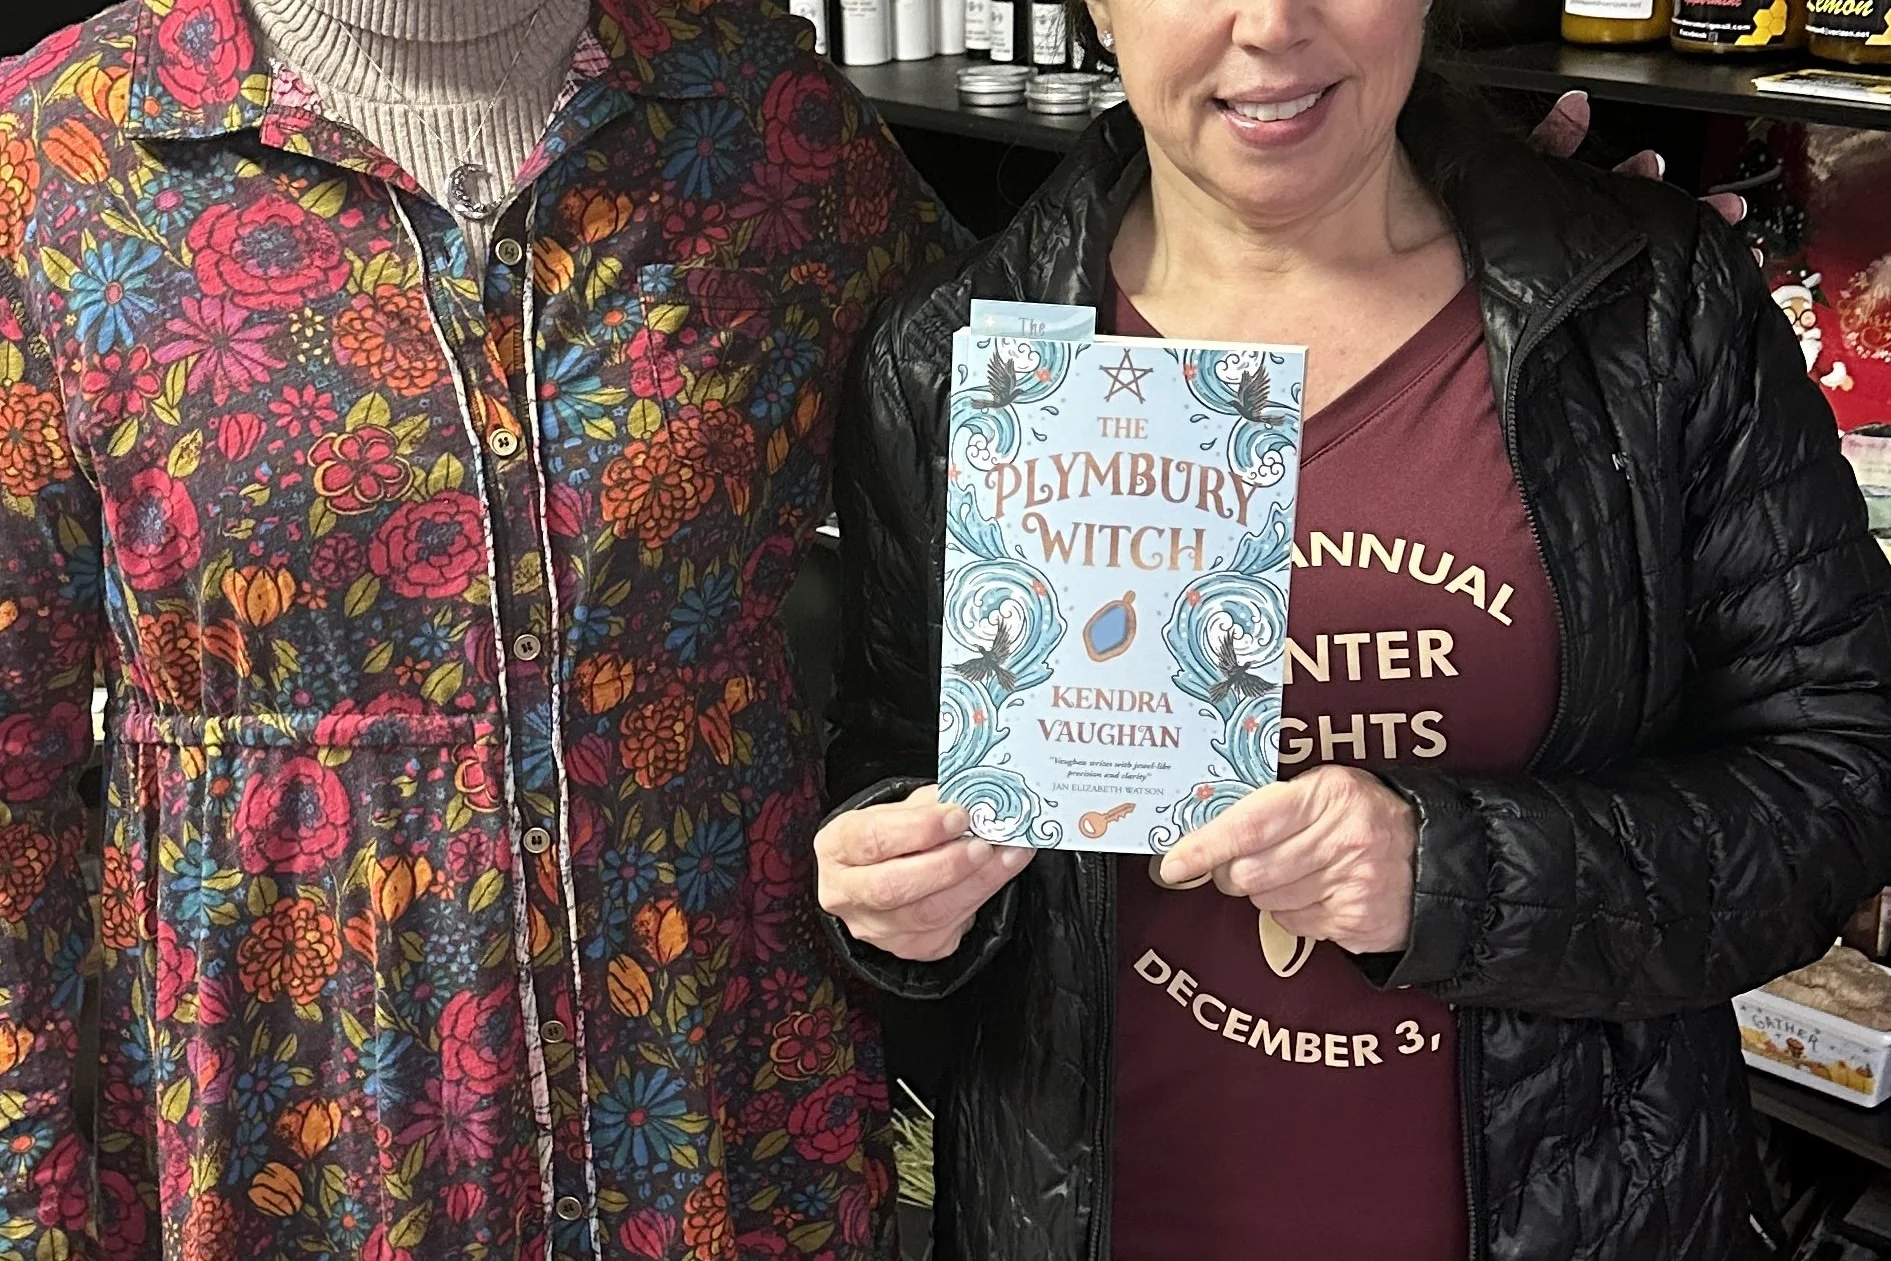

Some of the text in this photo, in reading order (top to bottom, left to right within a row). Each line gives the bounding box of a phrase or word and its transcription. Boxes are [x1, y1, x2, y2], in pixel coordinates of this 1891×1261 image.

[1018, 317, 1046, 337] The
[1097, 416, 1149, 439] THE
[985, 451, 1263, 527] PLYMBURY
[1022, 512, 1206, 572] WITCH
[1283, 629, 1459, 685] NTER
[1051, 685, 1174, 714] KENDRA
[1037, 719, 1182, 748] VAUGHAN
[1278, 710, 1447, 764] GHTS
[1067, 769, 1102, 779] precision
[1104, 771, 1119, 779] and
[1089, 759, 1112, 768] writes
[1114, 760, 1132, 769] with
[1052, 782, 1164, 796] JAN ELIZABETH WATSON
[1133, 948, 1441, 1068] DECEMBER 3,
[1752, 1014, 1819, 1053] GATHER
